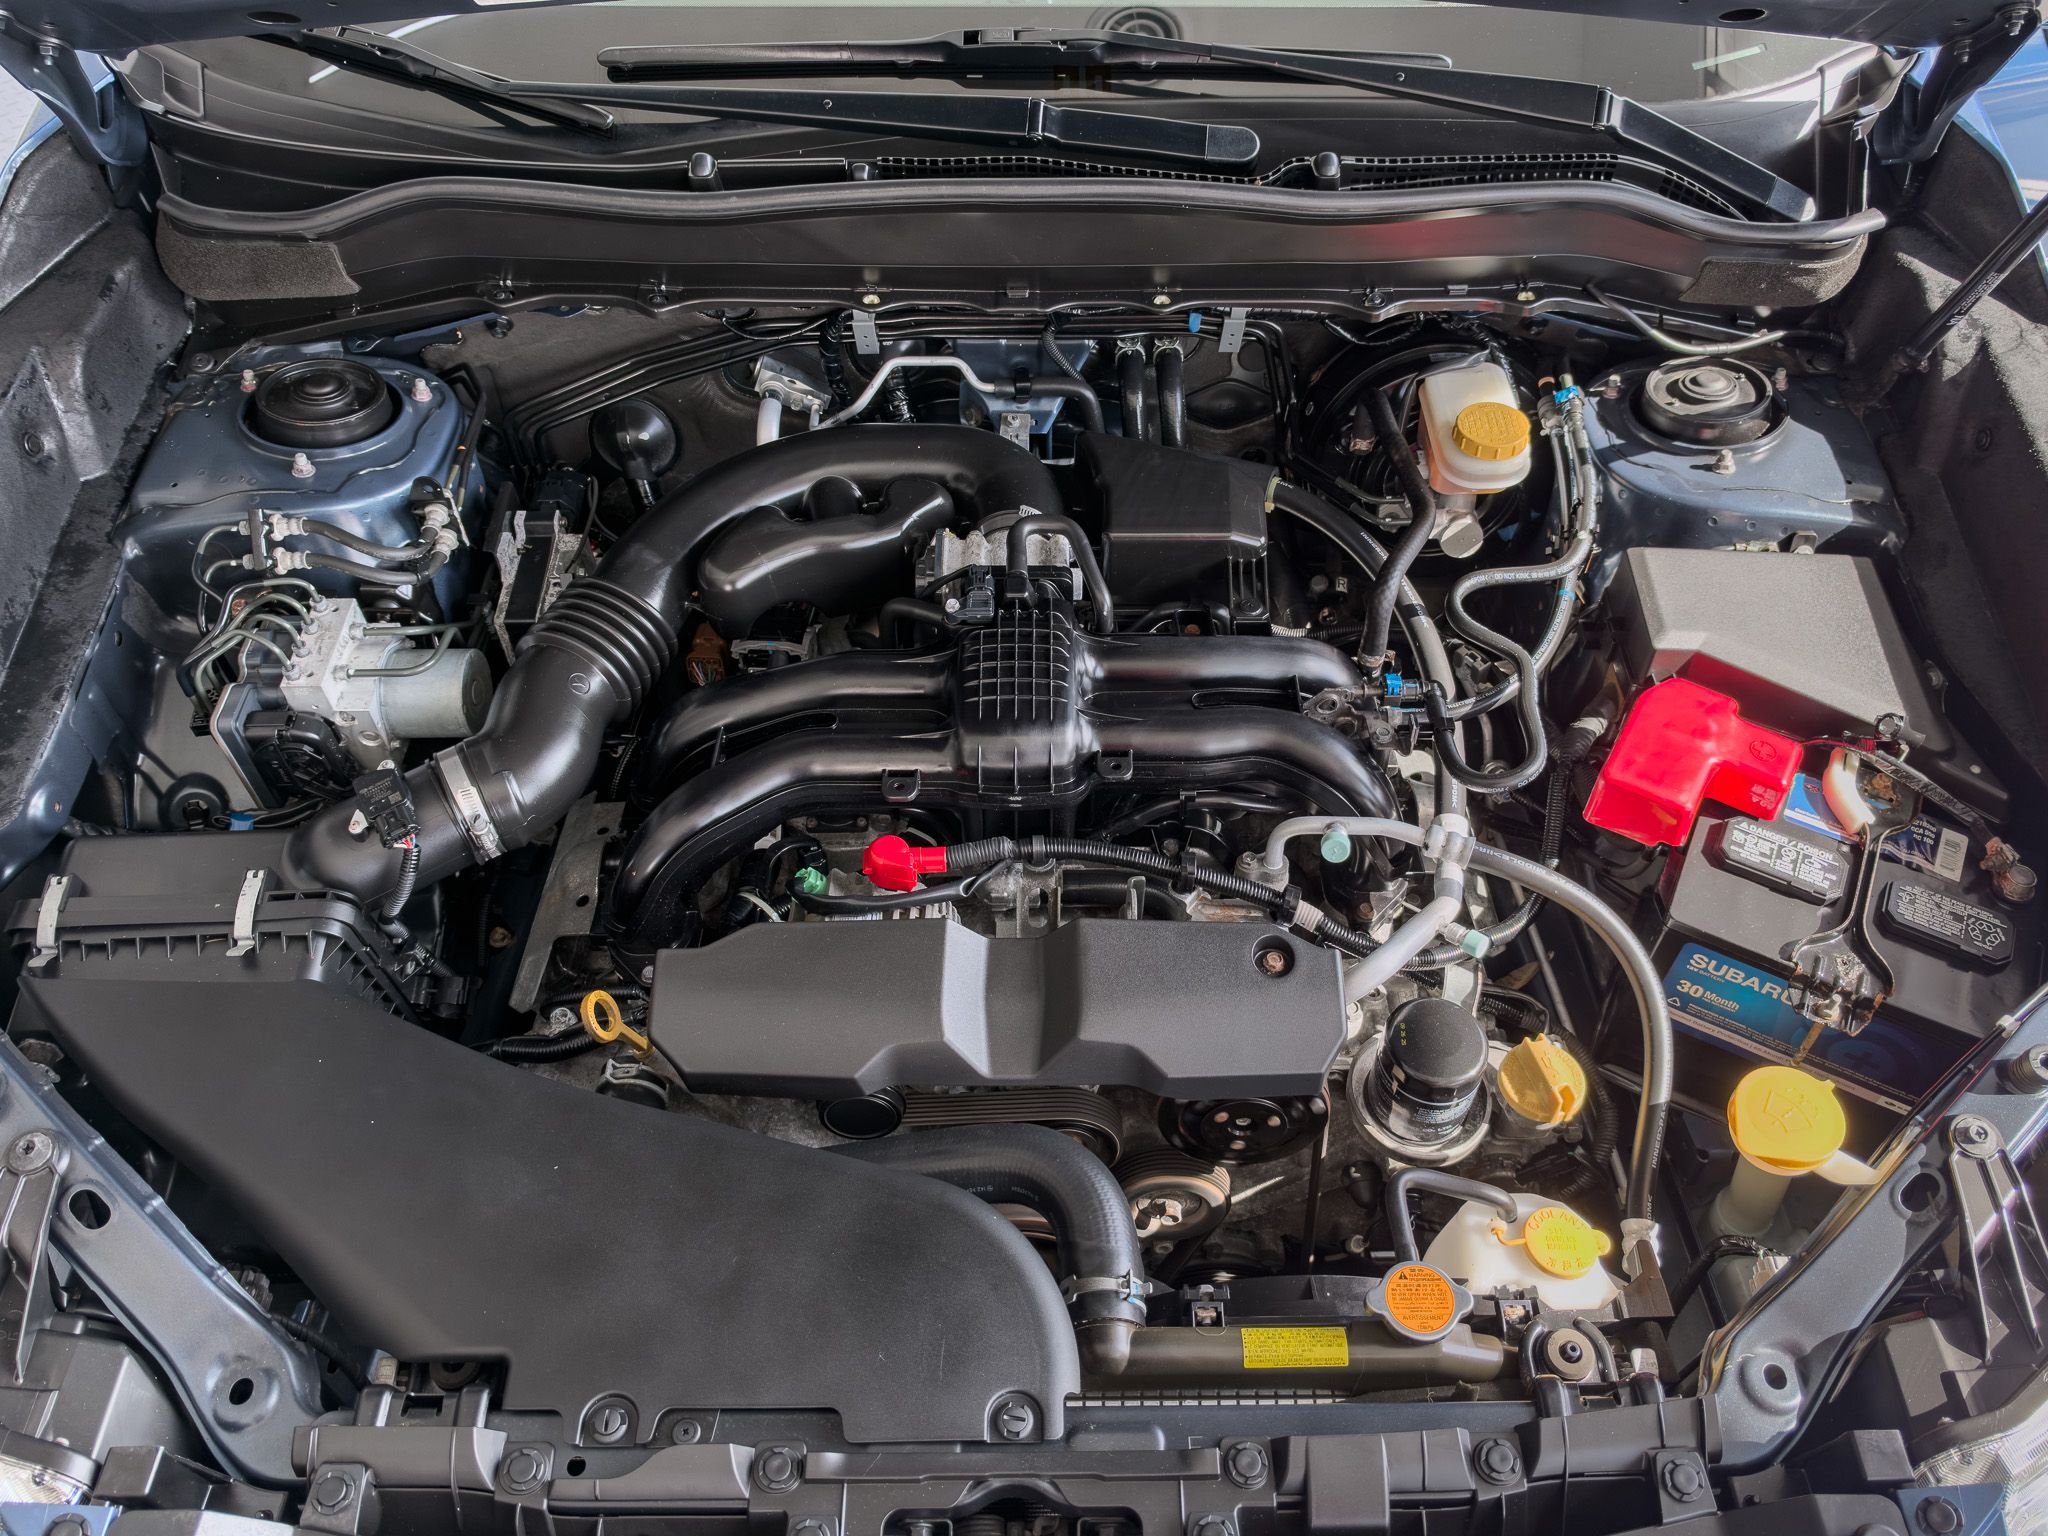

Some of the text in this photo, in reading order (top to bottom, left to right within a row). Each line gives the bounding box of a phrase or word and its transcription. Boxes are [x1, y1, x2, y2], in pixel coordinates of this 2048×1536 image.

[1337, 577, 1346, 590] R
[1749, 825, 1788, 844] DANGER
[1797, 842, 1834, 861] POISON
[1676, 979, 1704, 998] 30
[1703, 990, 1740, 1010] Month
